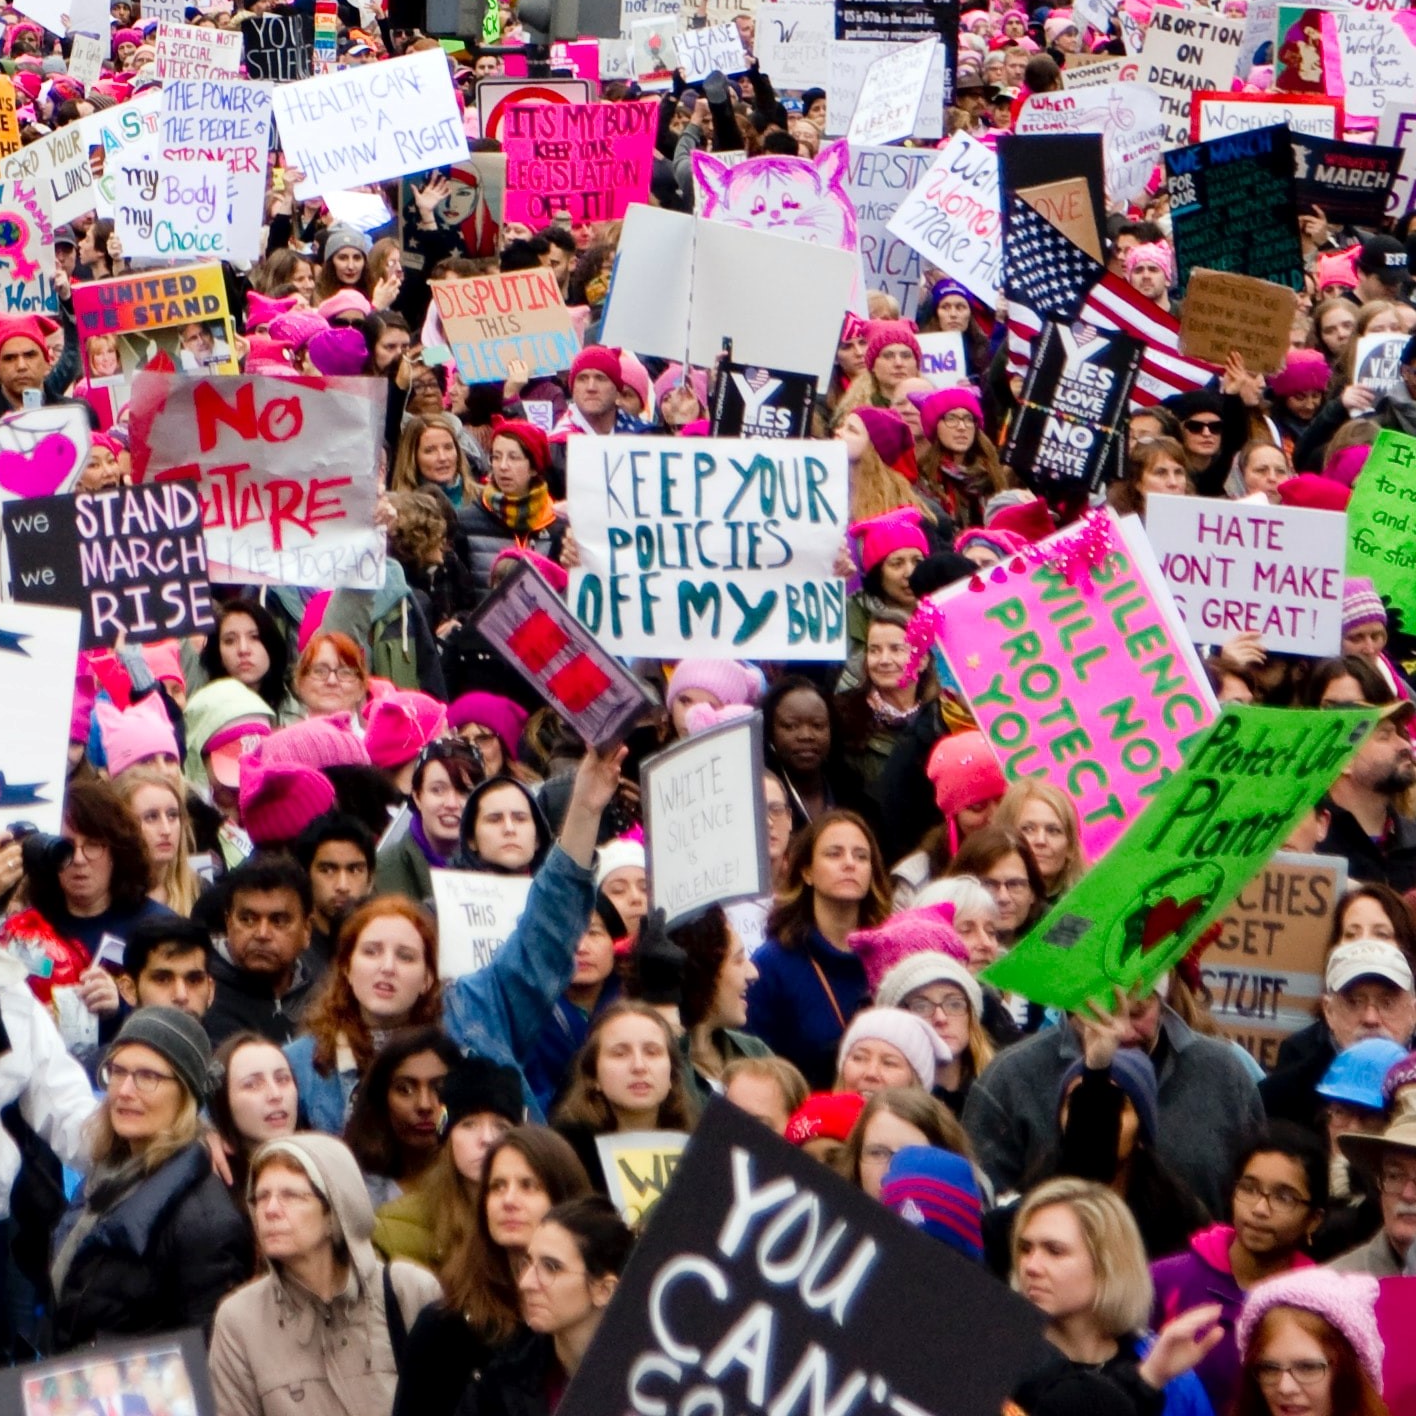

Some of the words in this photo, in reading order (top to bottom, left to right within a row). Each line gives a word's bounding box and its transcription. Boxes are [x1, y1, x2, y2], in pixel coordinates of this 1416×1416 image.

[1150, 11, 1243, 46] ABORTION
[170, 44, 211, 62] SPECIAL
[1177, 44, 1204, 64] ON
[164, 84, 199, 111] THE
[203, 83, 252, 110] POWER
[1149, 65, 1217, 92] DEMAND
[284, 81, 367, 123] HEALTH
[562, 107, 603, 136] MY
[606, 105, 656, 135] BODY
[164, 118, 196, 142] THE
[199, 118, 249, 141] PEOPLE
[394, 116, 460, 164] RIGHT
[507, 159, 640, 189] LEGISLATION
[1314, 164, 1391, 188] MARCH
[1324, 153, 1389, 170] WOMEN'S
[164, 176, 217, 222] Body
[6, 283, 58, 312] World
[99, 275, 197, 305] UNITED
[134, 294, 220, 325] STAND
[433, 269, 562, 318] DISPUTIN
[476, 313, 522, 340] THIS
[1054, 386, 1106, 414] LOVE
[1044, 416, 1094, 450] NO
[1038, 445, 1086, 472] HATE
[603, 450, 717, 520] KEEP
[723, 452, 839, 526] YOUR
[11, 512, 50, 534] we
[75, 485, 199, 538] STAND
[607, 520, 793, 573] POLICIES
[1197, 512, 1284, 551] HATE
[20, 566, 56, 586] we
[79, 537, 207, 586] MARCH
[1253, 561, 1340, 600] MAKE
[91, 581, 215, 637] RISE
[576, 571, 661, 639] OFF
[676, 580, 778, 646] MY
[1030, 563, 1111, 682] WILL
[1202, 597, 1319, 640] GREAT!
[971, 672, 1049, 782] YOU
[985, 596, 1126, 823] PROTECT
[657, 755, 724, 814] WHITE
[666, 800, 734, 856] SILENCE
[465, 904, 496, 927] THIS
[718, 1146, 877, 1329] YOU
